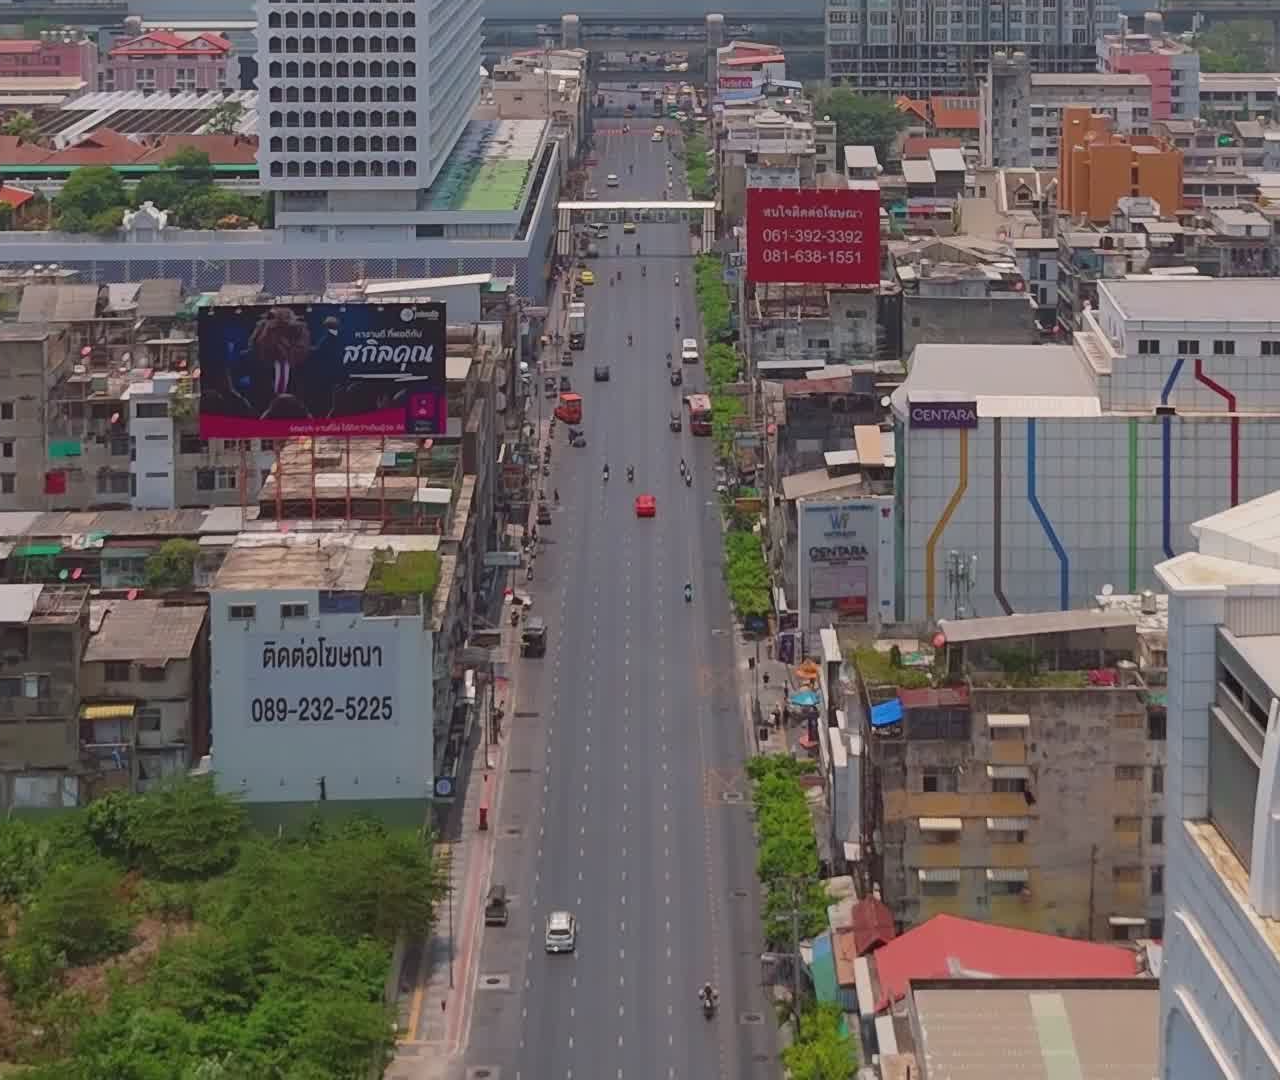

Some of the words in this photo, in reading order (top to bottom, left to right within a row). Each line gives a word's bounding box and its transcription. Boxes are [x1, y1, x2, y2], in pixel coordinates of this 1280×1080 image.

[763, 229, 863, 244] 061-392-3392
[763, 249, 862, 264] 081-638-1551
[343, 339, 433, 370] สกิลคุณ
[911, 408, 976, 421] CENTARA
[809, 546, 868, 558] CENTARA
[263, 637, 382, 669] ติดต่อโฆษณา
[252, 697, 392, 722] 089-232-5225
